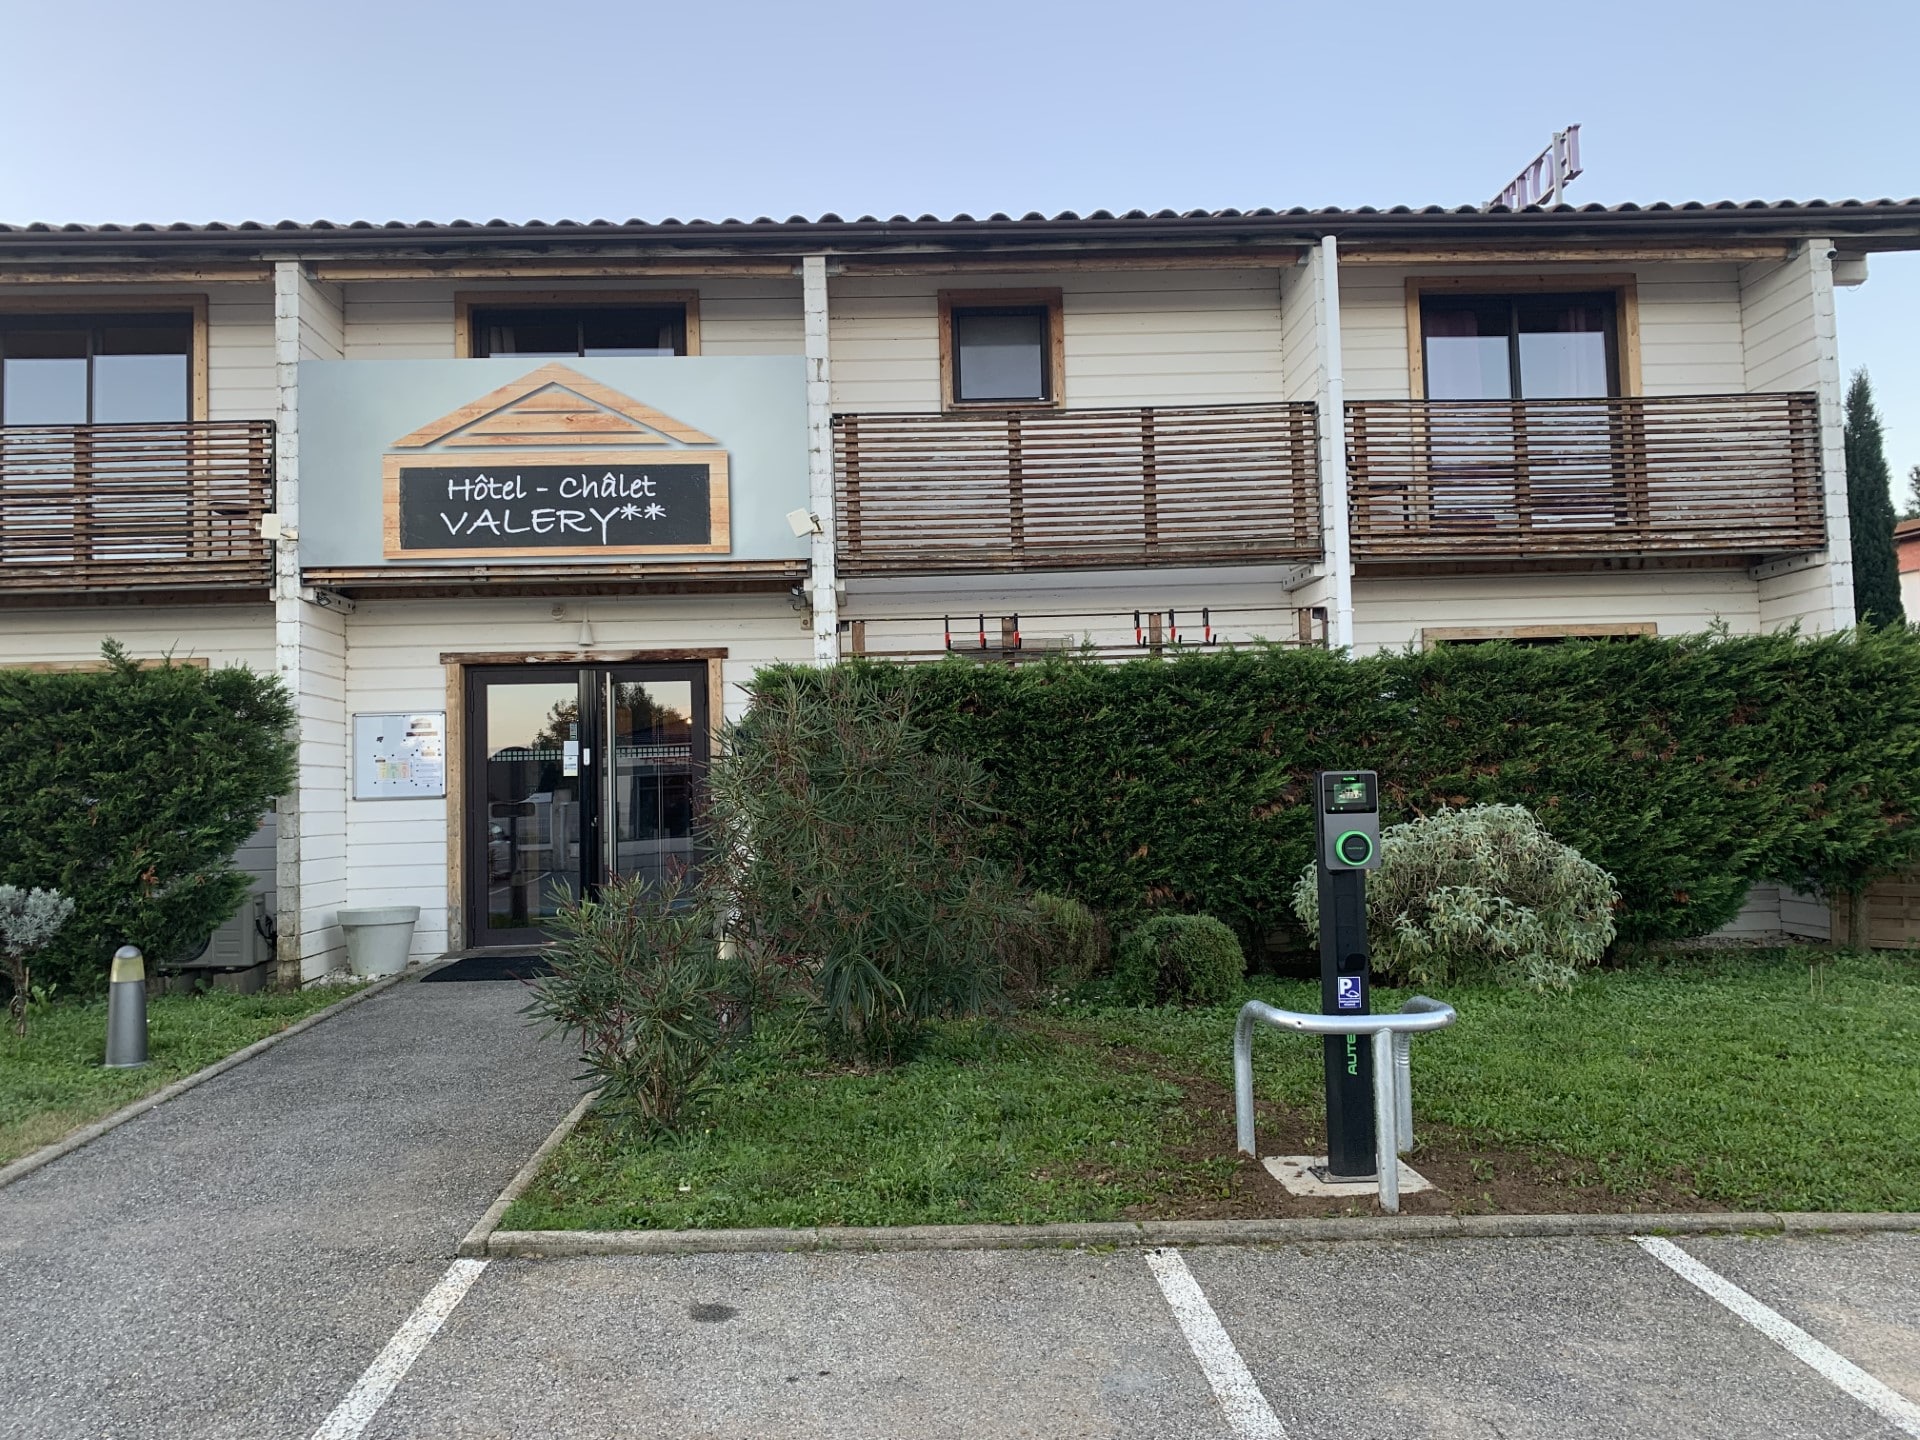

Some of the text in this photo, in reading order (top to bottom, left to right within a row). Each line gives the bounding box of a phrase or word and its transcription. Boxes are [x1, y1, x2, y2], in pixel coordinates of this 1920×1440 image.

[448, 474, 527, 501] Hôtel
[559, 472, 657, 499] Châlet
[1339, 978, 1353, 995] P
[1346, 1033, 1358, 1076] AUTE
